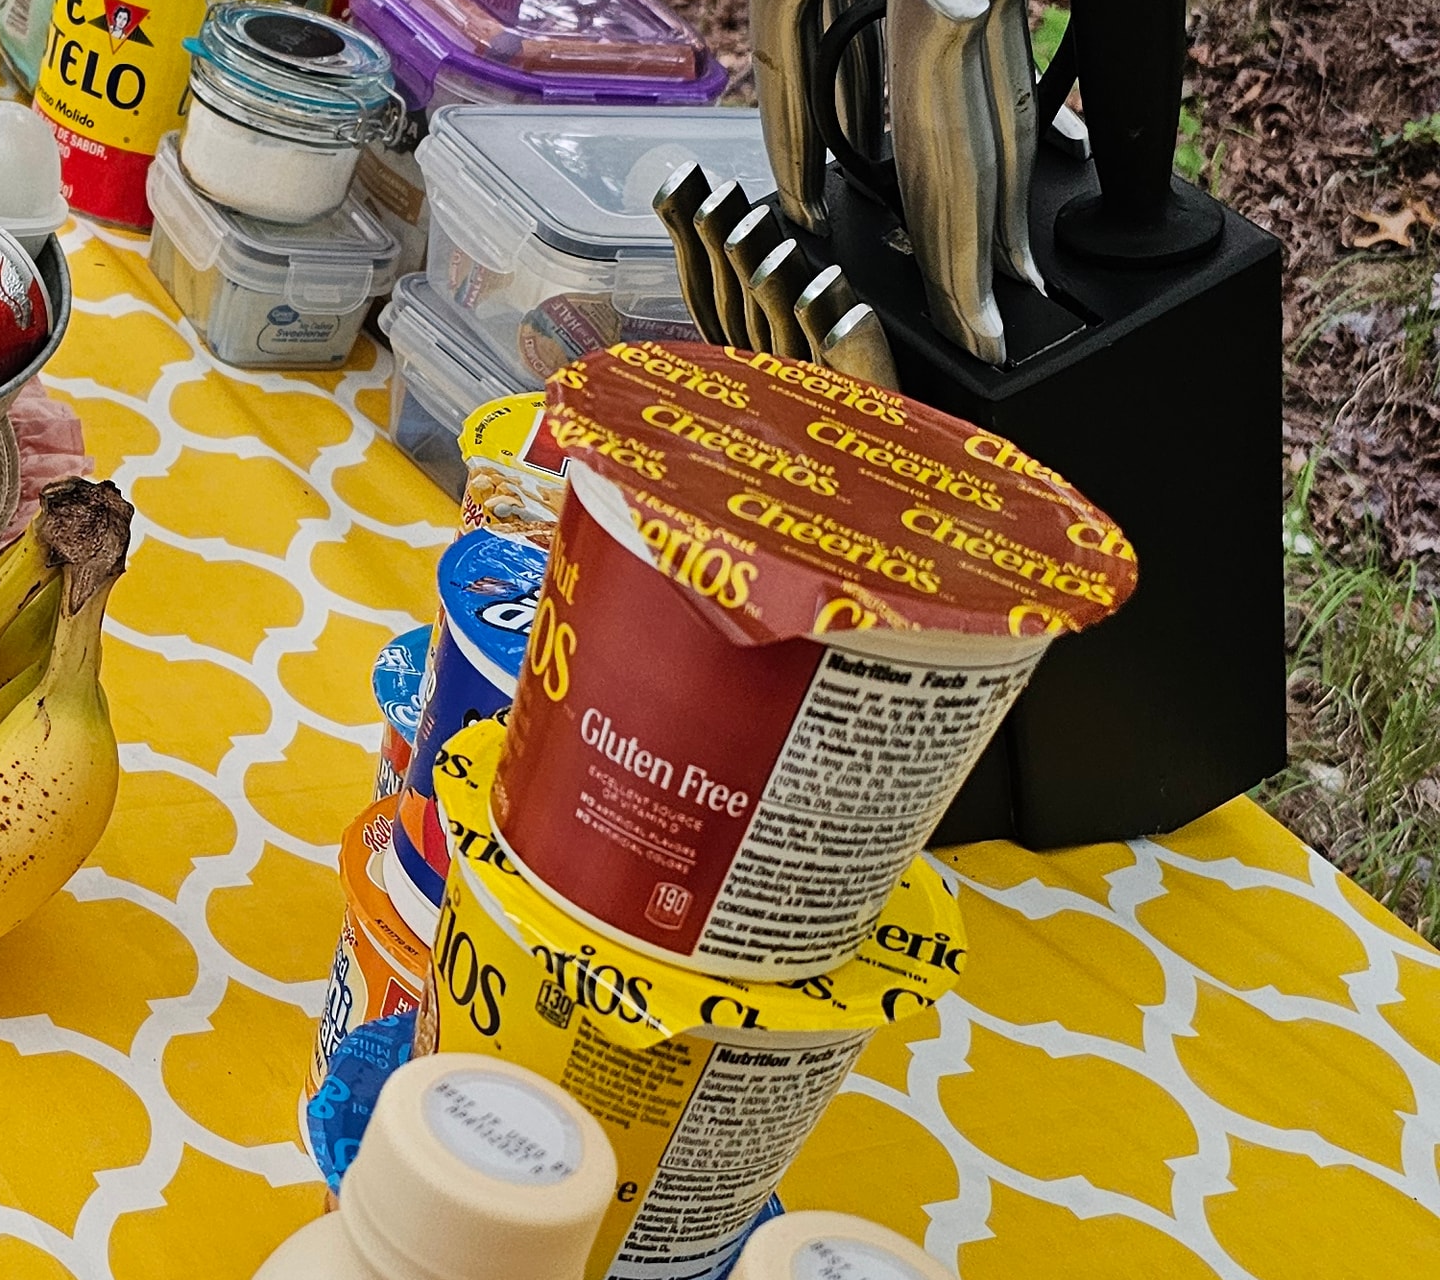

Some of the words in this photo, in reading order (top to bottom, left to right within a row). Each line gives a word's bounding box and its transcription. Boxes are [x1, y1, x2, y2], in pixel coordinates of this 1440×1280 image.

[47, 23, 146, 110] TELO
[54, 99, 95, 129] Molido
[57, 128, 71, 143] DE
[70, 131, 108, 160] SABOR,
[549, 300, 582, 332] HALF
[275, 327, 332, 338] Sweetener
[710, 371, 749, 393] Nut
[724, 346, 909, 426] Cheerios
[866, 386, 905, 410] Nut
[641, 405, 840, 497] Cheerios
[721, 423, 792, 463] Honey
[795, 451, 836, 477] Nut
[806, 421, 1005, 513] Cheerios
[885, 439, 953, 476] Honey
[957, 469, 998, 494] Nut
[727, 493, 942, 594] Cheerios
[814, 513, 887, 551] Honey
[892, 545, 936, 571] Nut
[901, 508, 1117, 606] Cheerios
[983, 527, 1058, 572] Honey
[1062, 562, 1109, 585] Nut
[825, 651, 912, 687] Nutrition
[920, 670, 968, 690] Facts
[810, 691, 864, 715] Saturated
[816, 677, 860, 699] Amount
[864, 692, 882, 705] per
[580, 707, 674, 791] Gluten
[678, 764, 749, 818] Free
[816, 739, 857, 758] Protein
[589, 765, 650, 806] EXCELLENT
[652, 802, 703, 832] SOURCE
[579, 791, 596, 808] NO
[595, 803, 647, 838] ARTIFICIAL
[648, 832, 697, 859] FLAVORS
[620, 799, 668, 830] VITAMIN
[668, 821, 680, 834] D
[363, 814, 393, 853] Kell
[575, 808, 591, 824] NO
[591, 820, 643, 856] ARTIFICIAL
[646, 849, 691, 875] COLORS
[655, 884, 689, 917] 190
[542, 984, 571, 1016] 130
[350, 1037, 391, 1059] Mills
[715, 1048, 791, 1067] Nutrition
[797, 1049, 837, 1066] Facts
[702, 1079, 750, 1093] Saturated
[706, 1069, 746, 1082] Amount
[707, 1116, 743, 1127] Protein
[676, 1133, 710, 1147] Vitamin
[647, 1189, 690, 1202] Preserve
[654, 1180, 714, 1192] Tripotassium
[642, 1202, 683, 1215] Vitamins
